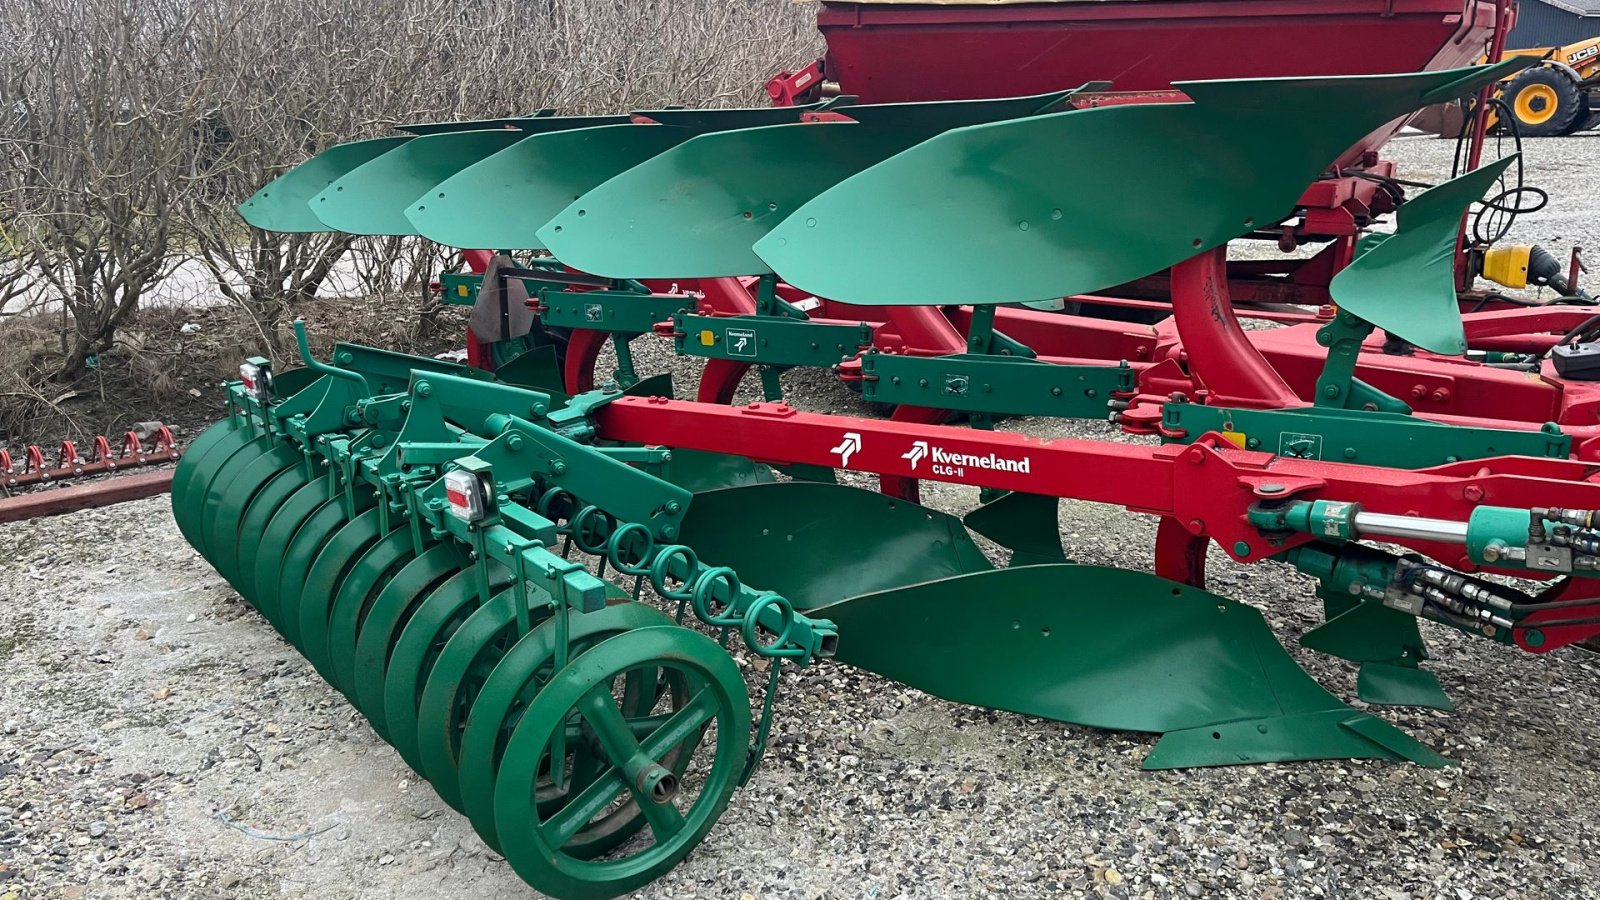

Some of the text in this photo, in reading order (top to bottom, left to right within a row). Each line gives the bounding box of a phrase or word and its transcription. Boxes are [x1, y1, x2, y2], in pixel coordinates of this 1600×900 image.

[1568, 45, 1599, 62] JCB
[931, 446, 1030, 474] Kverneland
[932, 464, 964, 477] CLG-II
